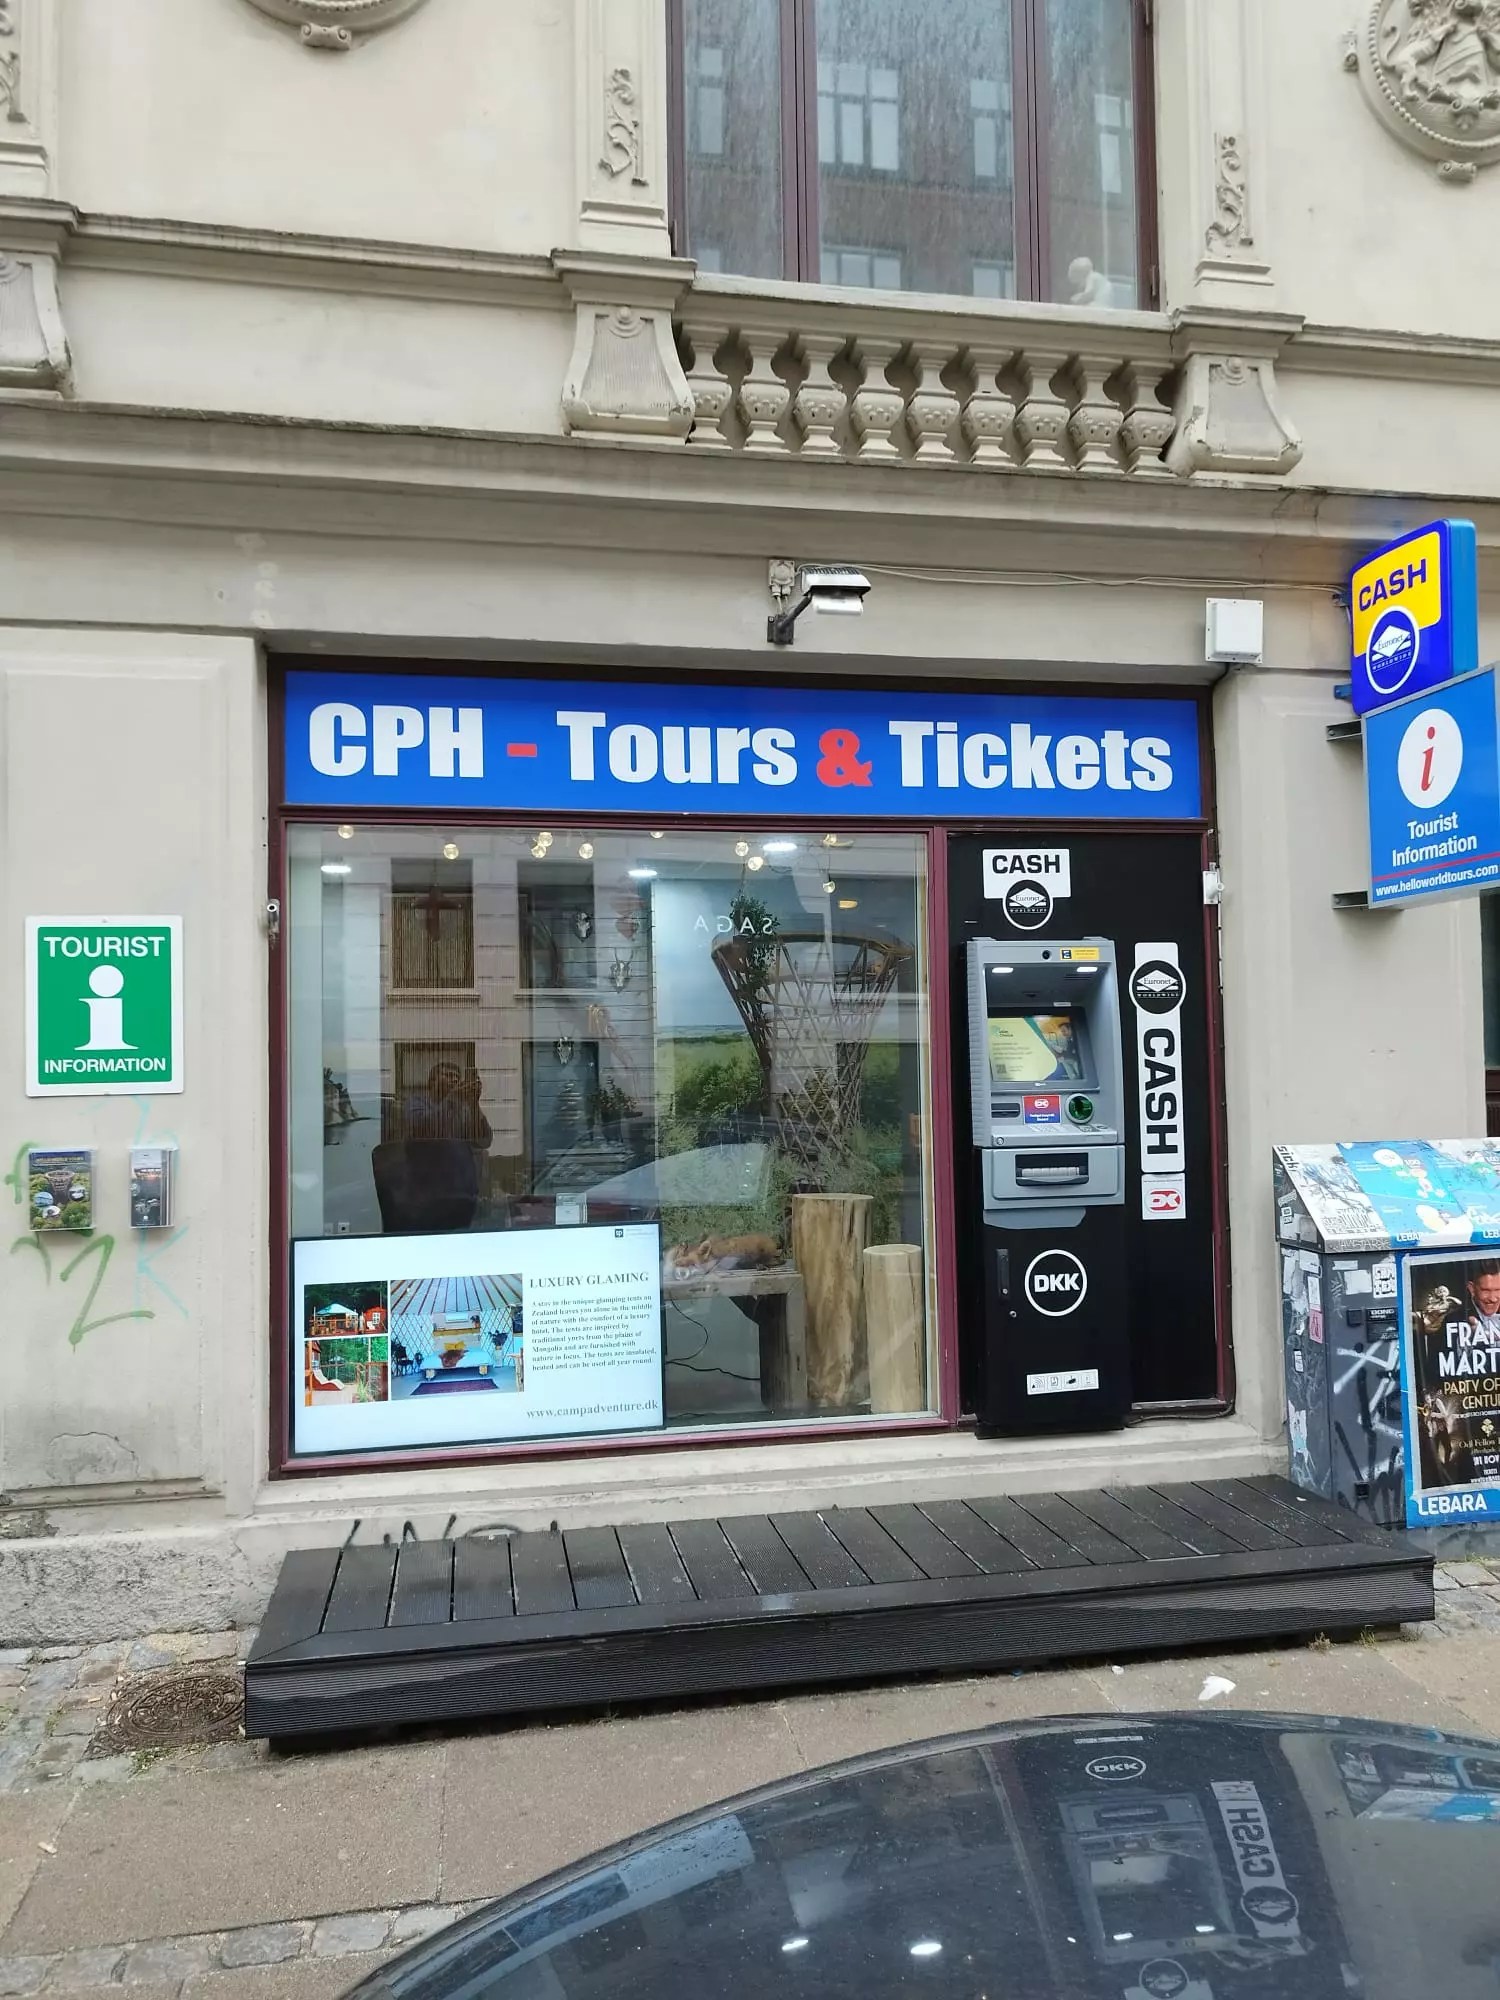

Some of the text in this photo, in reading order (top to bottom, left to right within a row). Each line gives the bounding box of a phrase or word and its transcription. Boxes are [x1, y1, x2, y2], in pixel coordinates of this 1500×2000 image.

[1359, 557, 1427, 613] CASH
[308, 703, 1174, 792] CPH - Tours & Tickets
[1407, 811, 1459, 840] Tourist
[1391, 833, 1478, 867] Information
[992, 854, 1060, 874] CASH
[1375, 863, 1499, 897] www.helloworldtours.com
[44, 936, 165, 958] TOURIST
[1143, 977, 1172, 985] Euronet
[44, 1057, 166, 1073] INFORMATION
[1142, 1028, 1179, 1155] CASH
[530, 1271, 649, 1289] LUXURY GLAMING
[1034, 1272, 1080, 1292] DKK
[595, 1296, 626, 1304] glamping
[531, 1308, 558, 1317] Zealand
[580, 1308, 592, 1316] you
[539, 1318, 561, 1326] nature
[578, 1316, 588, 1324] the
[589, 1313, 615, 1322] comfort
[630, 1312, 650, 1320] luxury
[565, 1325, 581, 1333] tents
[594, 1323, 620, 1332] inspired
[621, 1322, 629, 1331] by
[531, 1336, 566, 1344] traditional
[586, 1332, 602, 1341] from
[603, 1332, 613, 1340] the
[614, 1330, 634, 1340] plains
[532, 1344, 563, 1353] Mongolia
[564, 1343, 576, 1351] and
[590, 1340, 620, 1349] furnished
[621, 1339, 636, 1347] with
[532, 1354, 554, 1362] nature
[583, 1351, 596, 1359] The
[597, 1350, 613, 1358] tents
[532, 1363, 554, 1371] heated
[555, 1362, 568, 1370] and
[591, 1359, 606, 1368] used
[607, 1358, 616, 1366] all
[616, 1358, 630, 1367] year
[1444, 1379, 1480, 1396] PARTY
[526, 1399, 659, 1420] www.campadventure.dk
[1474, 1437, 1495, 1448] Fellow
[1418, 1493, 1488, 1517] LEBARA
